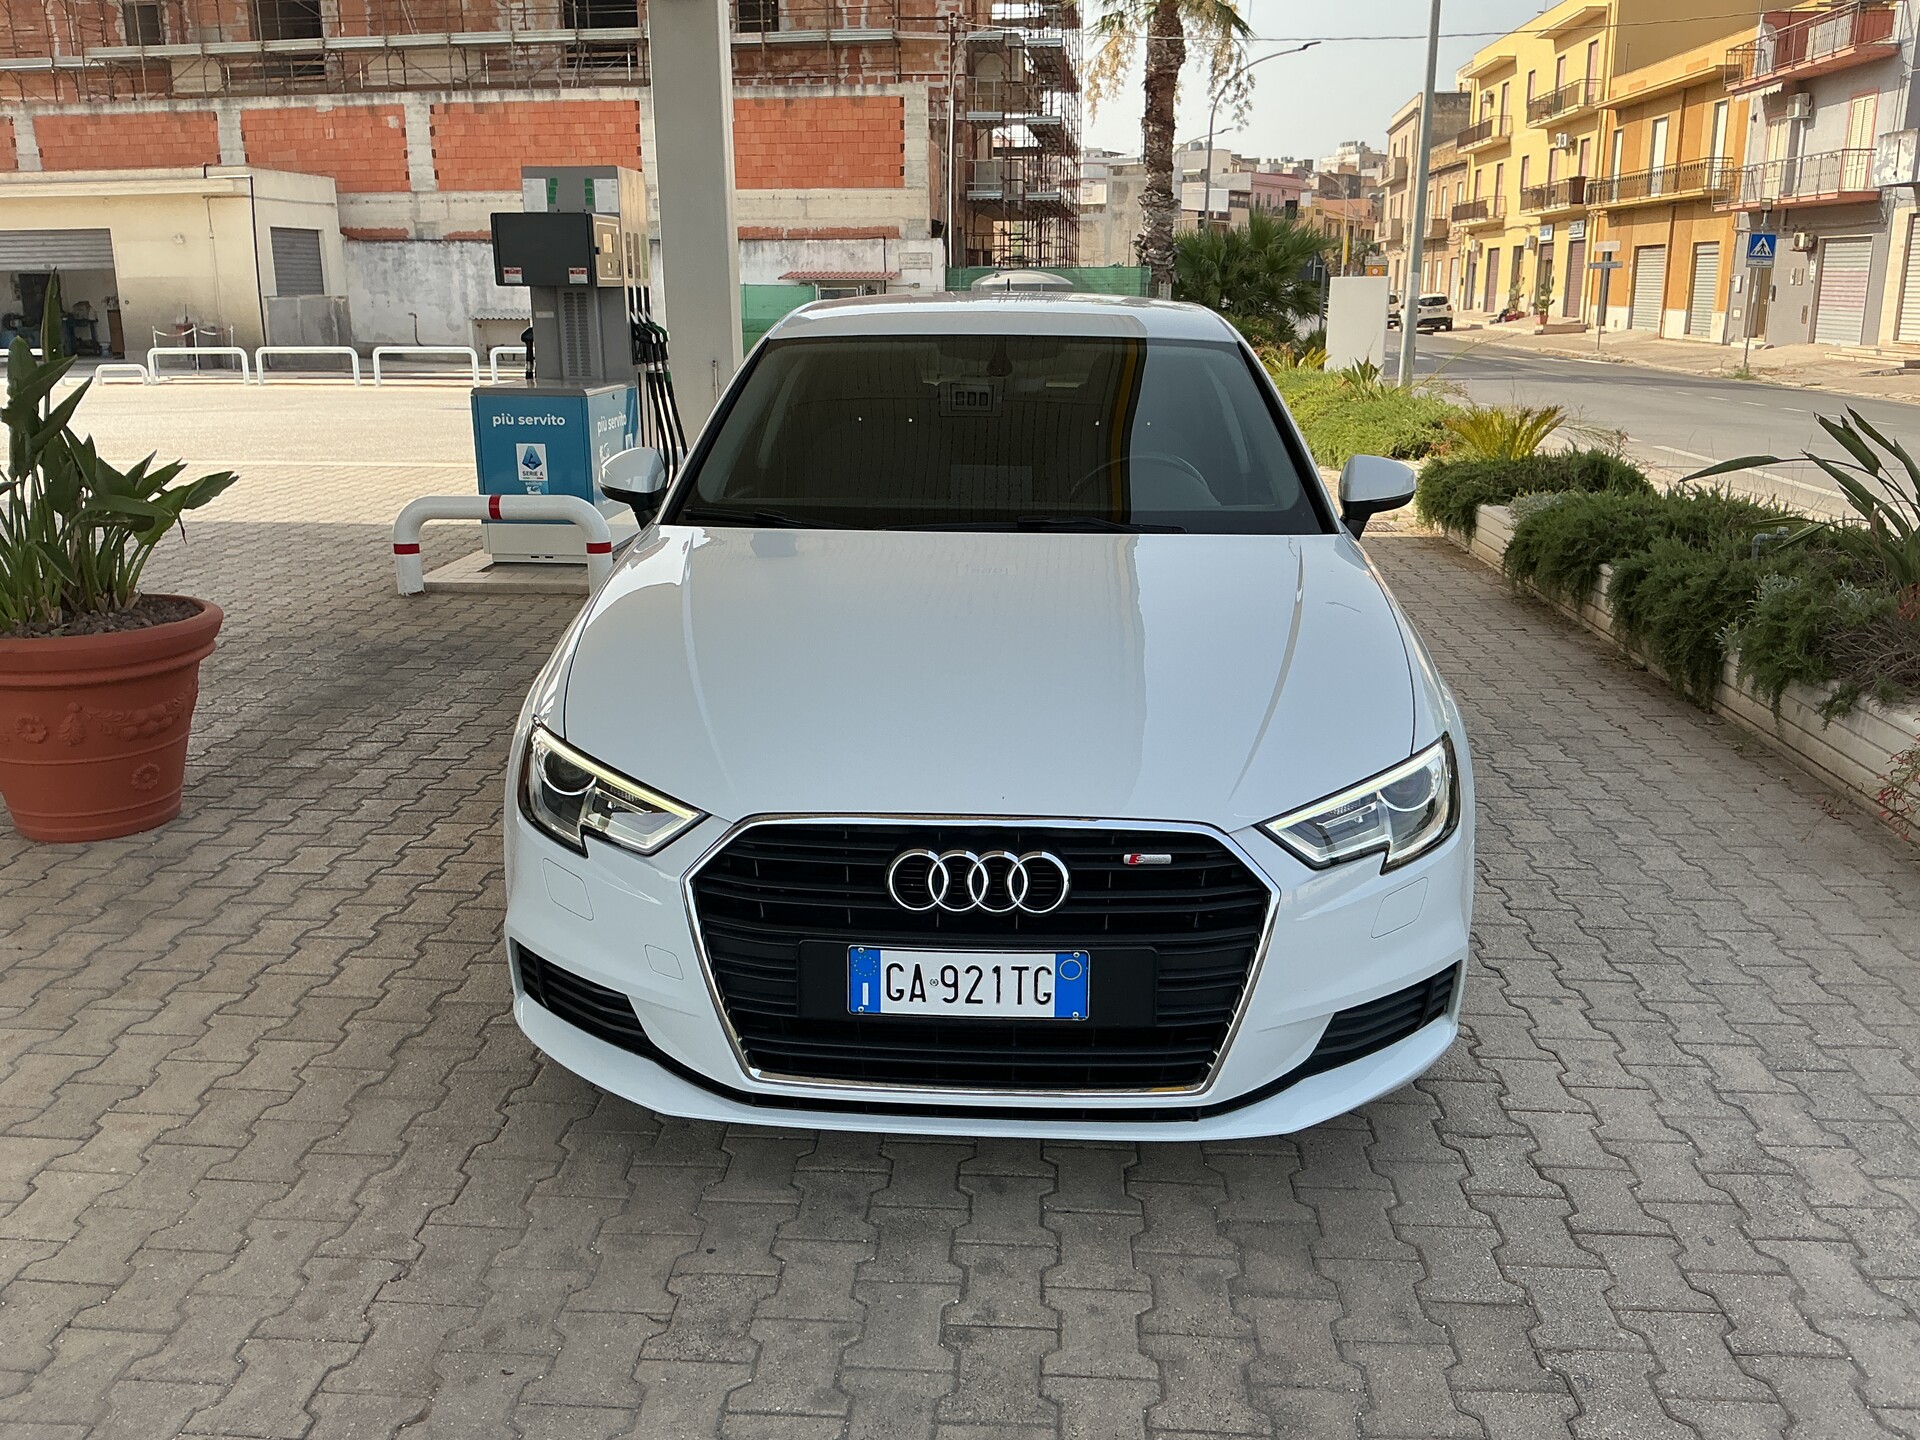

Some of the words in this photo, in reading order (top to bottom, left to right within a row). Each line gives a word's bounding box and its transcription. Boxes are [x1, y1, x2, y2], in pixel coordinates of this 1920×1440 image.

[492, 413, 514, 428] più
[518, 413, 566, 426] servito
[608, 411, 627, 430] servito
